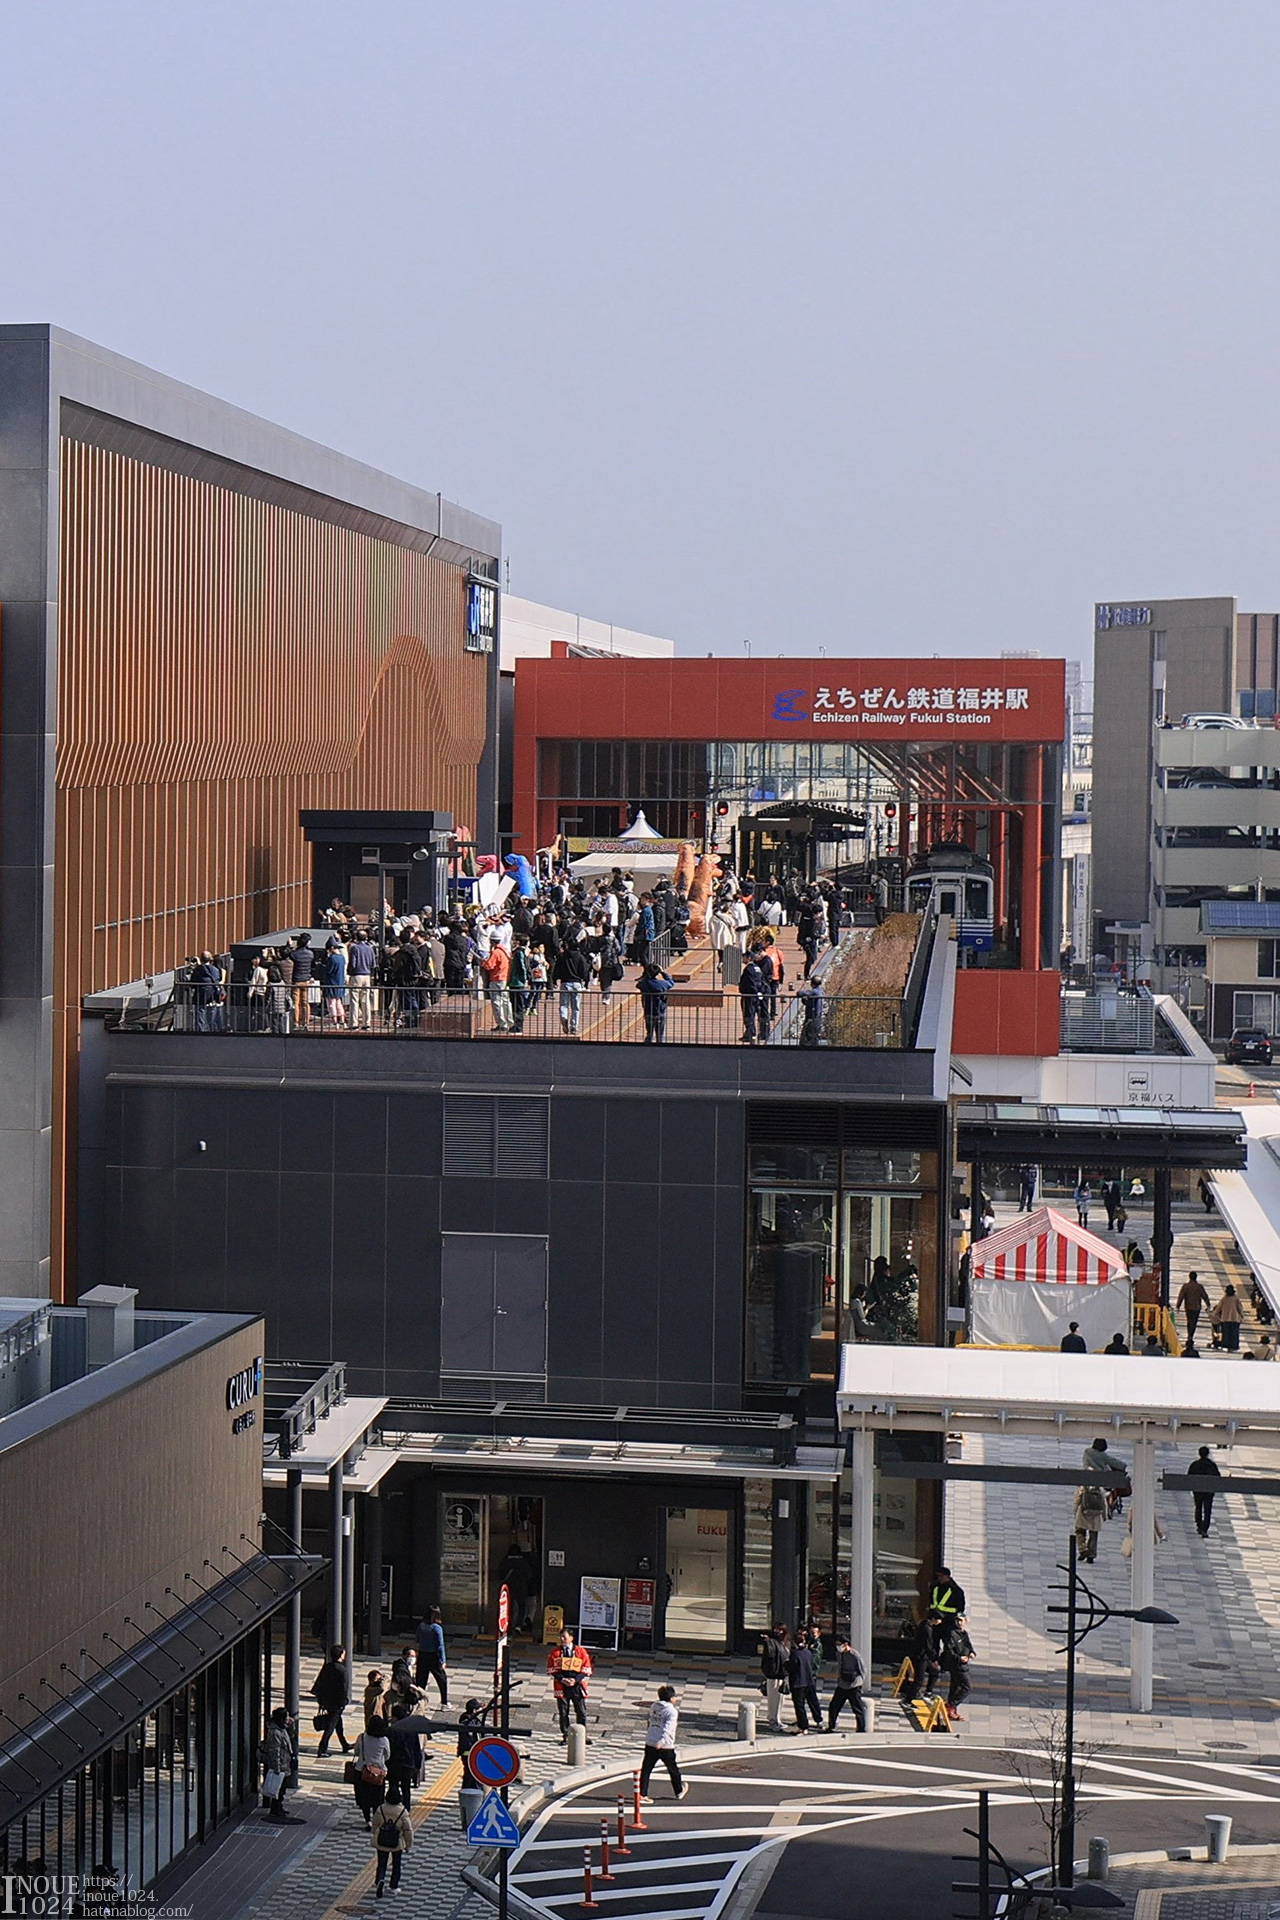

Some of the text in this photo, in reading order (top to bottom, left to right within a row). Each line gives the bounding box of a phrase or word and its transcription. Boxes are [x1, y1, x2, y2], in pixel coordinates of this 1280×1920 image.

[813, 687, 1029, 710] えちぜん鉄道福井駅
[812, 712, 991, 725] Echizen Railway Fukui Station
[1128, 1092, 1175, 1102] 京福バス
